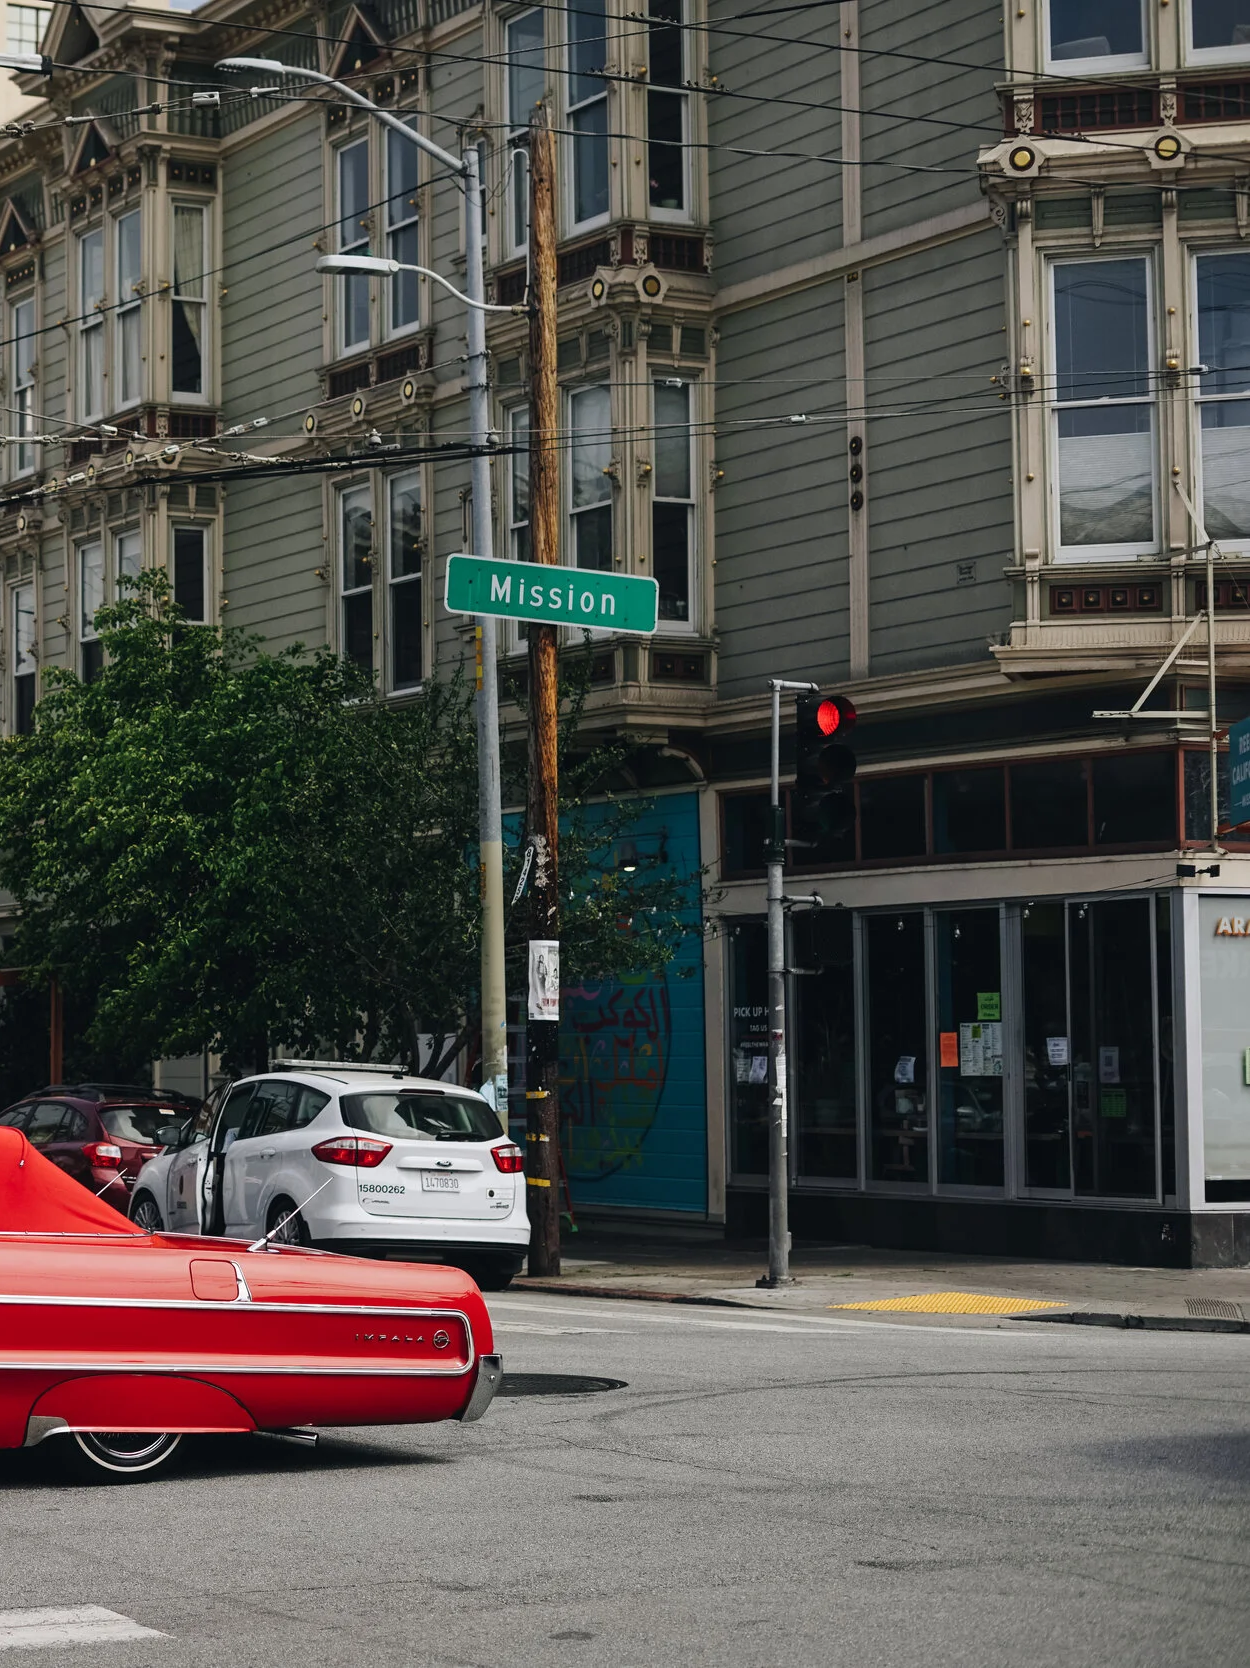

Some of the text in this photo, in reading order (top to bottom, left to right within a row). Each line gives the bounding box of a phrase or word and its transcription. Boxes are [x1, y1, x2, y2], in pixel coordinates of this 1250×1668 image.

[490, 574, 616, 615] Mission
[734, 1007, 750, 1017] PICK
[753, 1006, 763, 1016] UP
[358, 1184, 406, 1195] 15800262
[355, 1333, 425, 1342] IMPALA
